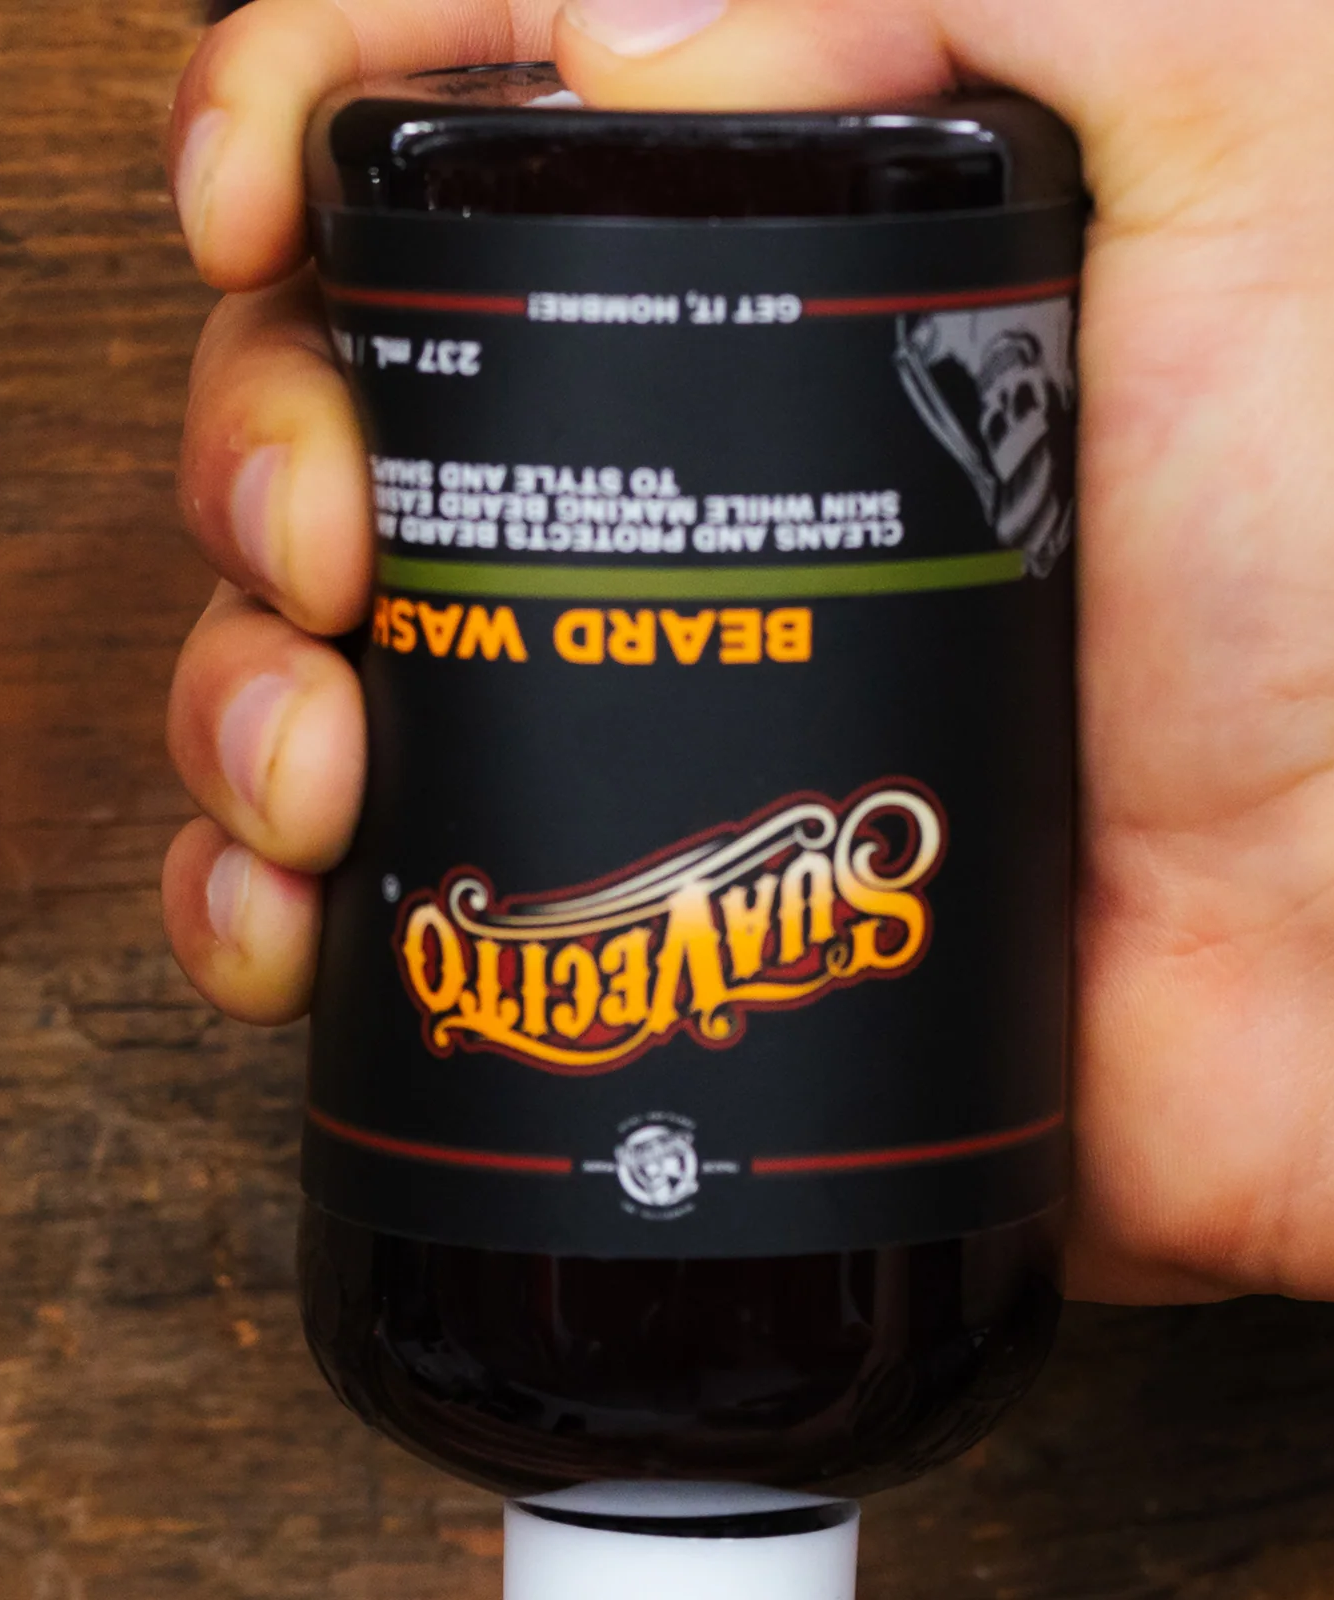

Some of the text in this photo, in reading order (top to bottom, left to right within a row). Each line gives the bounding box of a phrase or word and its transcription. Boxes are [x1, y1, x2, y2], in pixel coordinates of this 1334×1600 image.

[527, 289, 802, 324] GET IT, HOMBRE!
[416, 338, 482, 377] 237
[438, 460, 507, 493] AND
[513, 464, 623, 497] STYLE
[629, 466, 680, 498] TO
[438, 492, 549, 523] BEARD
[554, 495, 697, 526] MAKING
[704, 492, 815, 525] WHILE
[820, 489, 901, 523] SKIN
[399, 515, 499, 549] BEARD
[503, 521, 686, 553] PROTECTS
[691, 522, 767, 553] AND
[773, 518, 904, 552] CLEANS
[553, 607, 813, 665] BEARD
[399, 790, 941, 1069] SUAVECITO
